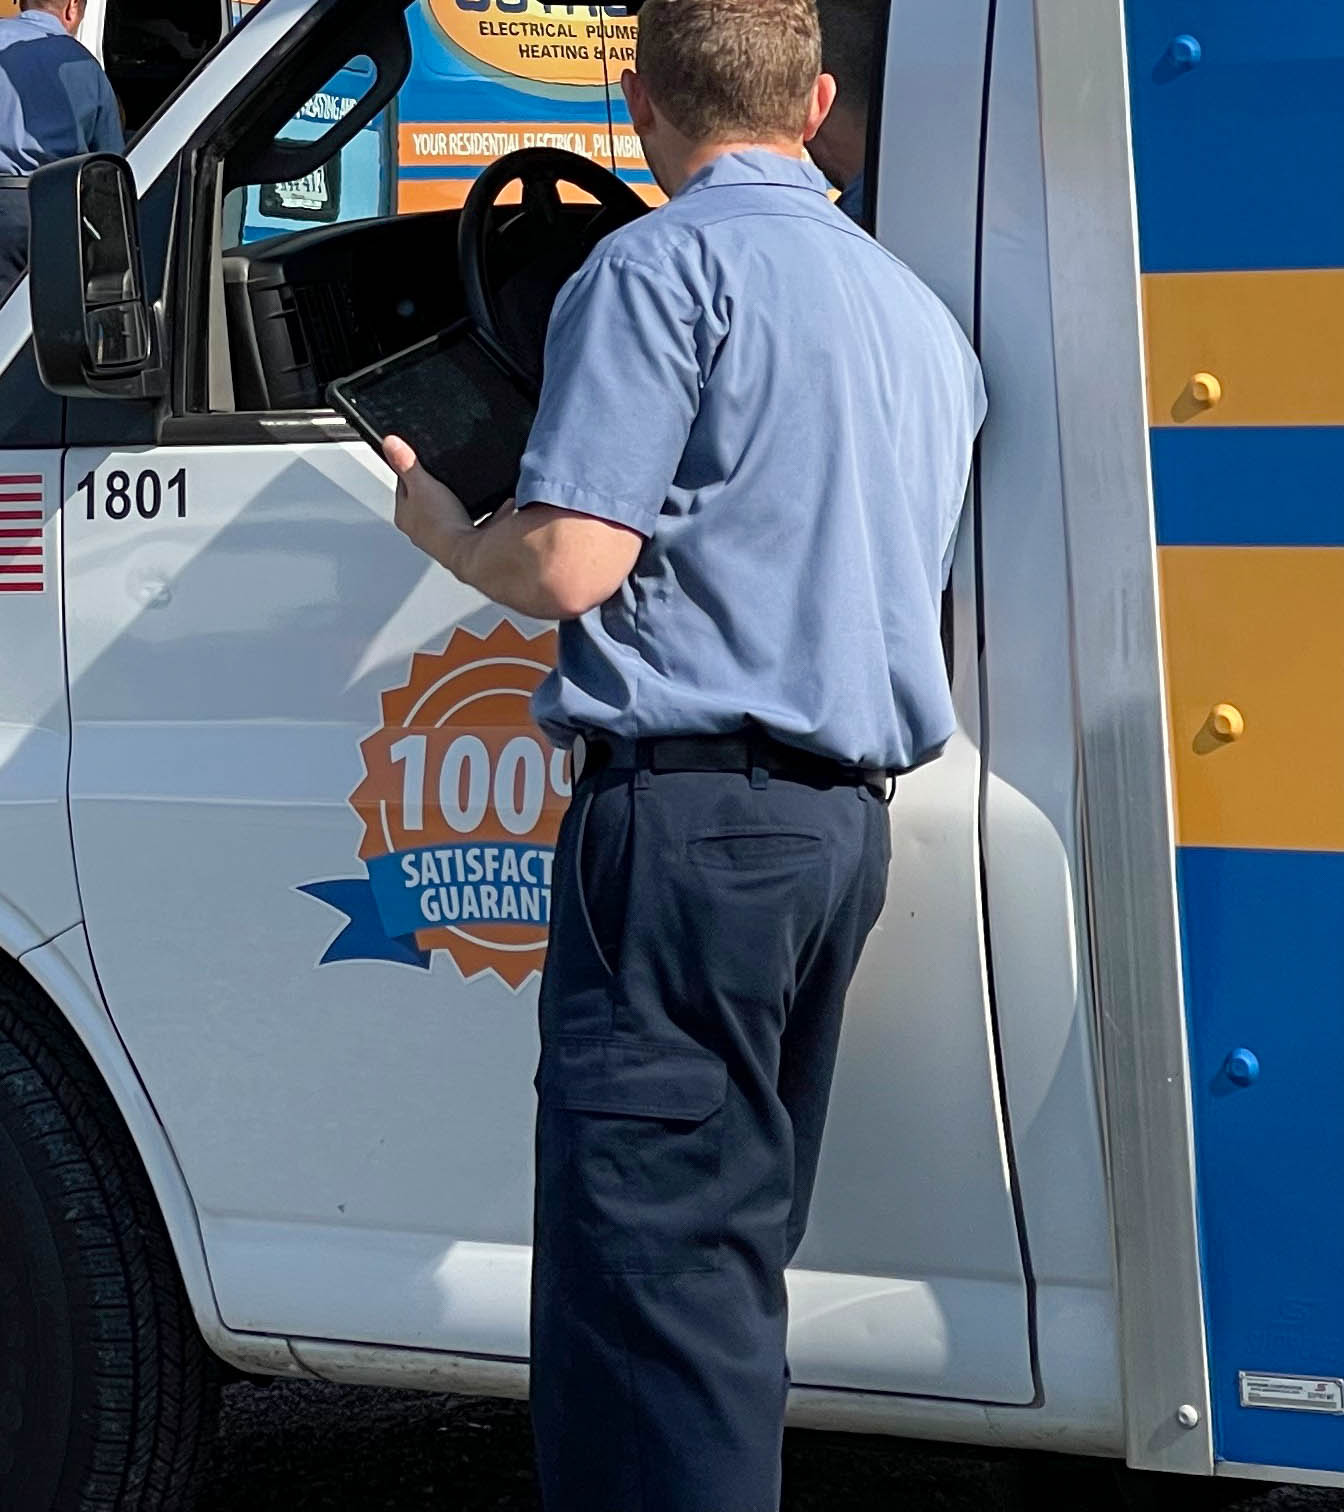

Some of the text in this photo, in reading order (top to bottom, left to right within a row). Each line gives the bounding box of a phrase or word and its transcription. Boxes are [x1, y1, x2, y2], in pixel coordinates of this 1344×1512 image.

[479, 20, 577, 38] ELECTRICAL
[519, 44, 589, 60] HEATING
[609, 46, 635, 61] AIR
[412, 133, 446, 156] YOUR
[448, 133, 519, 156] RESIDENTIAL
[77, 468, 186, 520] 1801
[401, 848, 555, 888] SATISFACT
